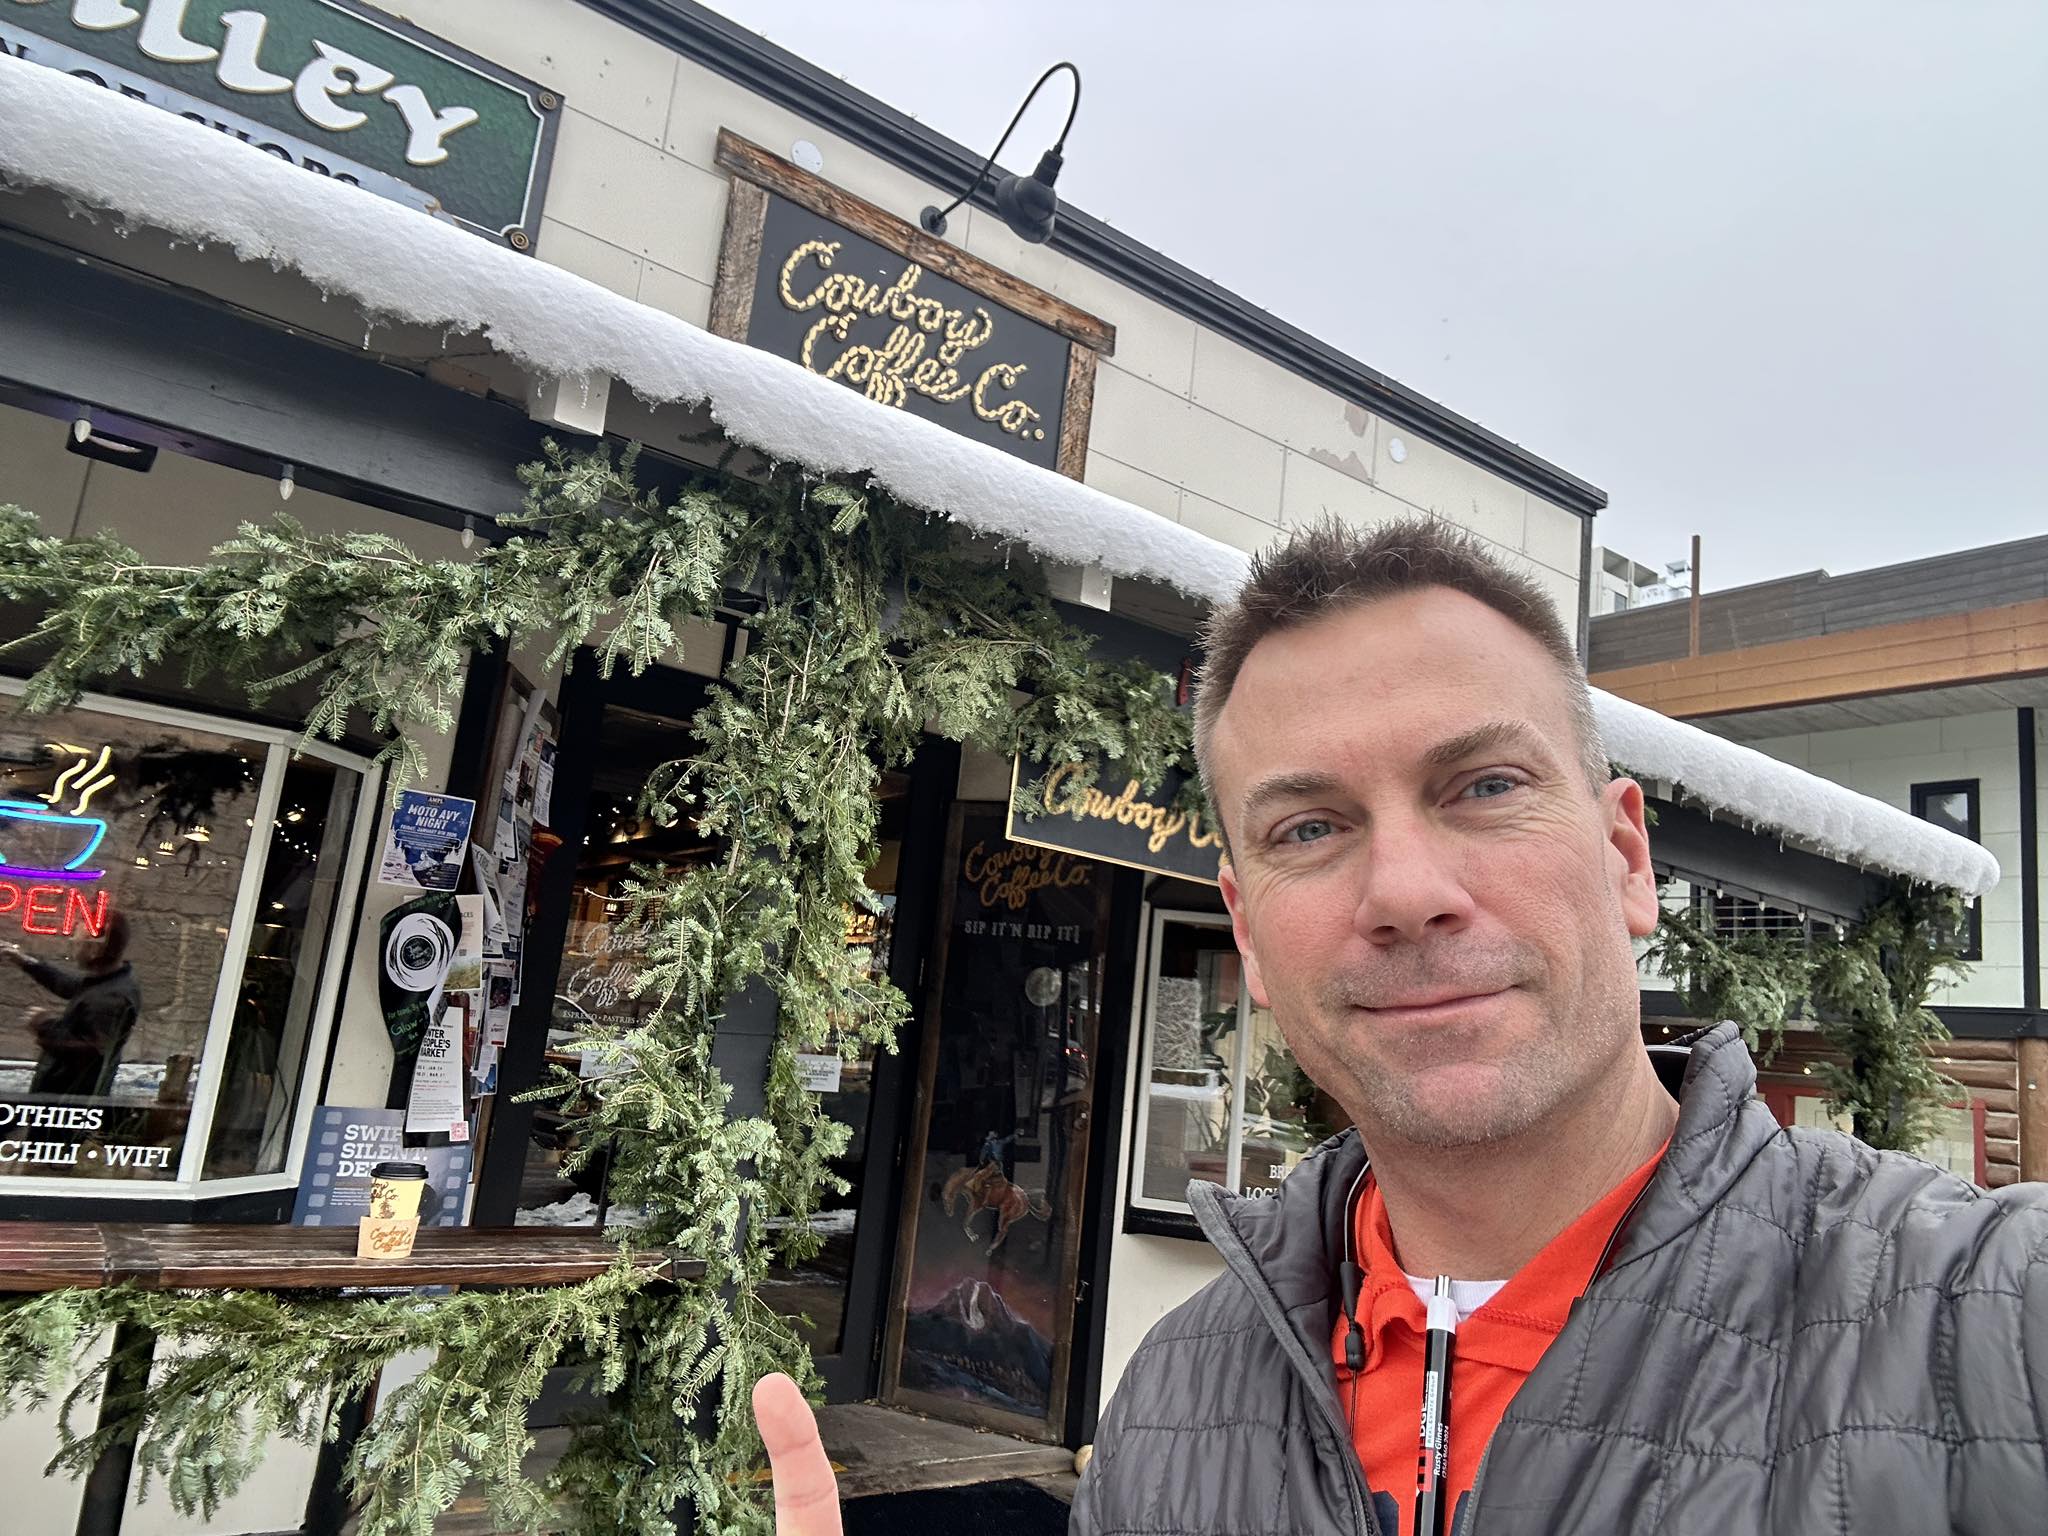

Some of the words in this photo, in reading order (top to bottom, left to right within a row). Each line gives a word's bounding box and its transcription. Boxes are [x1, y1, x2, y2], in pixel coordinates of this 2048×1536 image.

[15, 0, 480, 166] LLEY
[779, 238, 993, 367] Cowboy
[802, 311, 972, 408] Coffee
[407, 804, 438, 818] MOTO
[415, 816, 449, 830] NIGHT
[964, 920, 986, 935] SIP
[1026, 924, 1052, 940] RIP
[602, 1014, 636, 1024] PASTRIES
[426, 1028, 445, 1039] NTER
[423, 1037, 451, 1049] EOPLE'S
[0, 1140, 81, 1165] CHILI
[104, 1145, 171, 1169] WIFI
[336, 1161, 374, 1178] DE
[1245, 1186, 1278, 1201] LOC
[1434, 1422, 1443, 1450] Glines
[1433, 1449, 1442, 1476] Rusty
